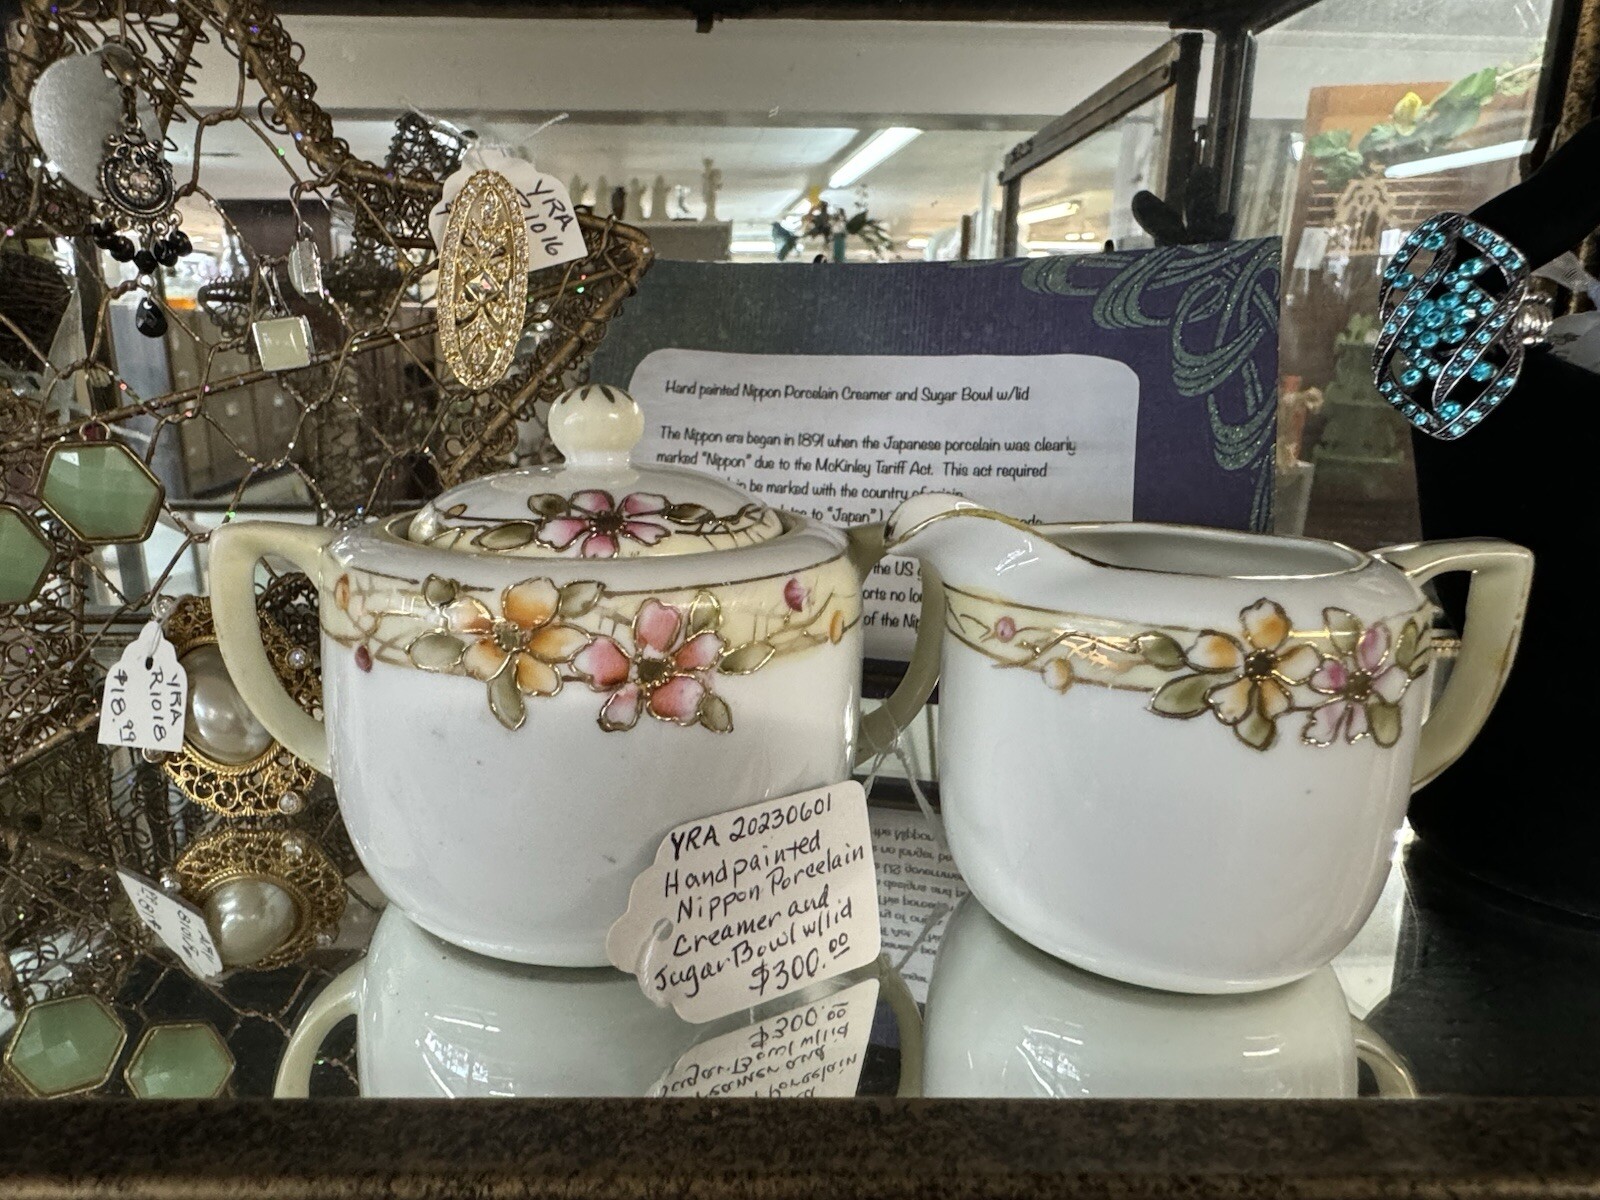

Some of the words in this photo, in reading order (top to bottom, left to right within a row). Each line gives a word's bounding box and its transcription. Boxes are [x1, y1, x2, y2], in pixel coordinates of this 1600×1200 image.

[527, 179, 574, 232] YRA
[665, 380, 697, 395] Hand
[700, 383, 740, 399] painted
[742, 384, 781, 402] Nippon
[784, 385, 838, 400] Porcelain
[841, 386, 892, 401] Creamer
[895, 387, 918, 401] and
[920, 387, 958, 405] Sugar
[961, 387, 993, 401] Bowl
[996, 386, 1030, 401] w/lid
[661, 425, 680, 440] The
[684, 428, 722, 446] Nippon
[725, 433, 744, 444] era
[746, 431, 781, 448] began
[784, 434, 794, 445] in
[798, 433, 824, 447] 1891
[828, 434, 858, 449] when
[862, 435, 880, 450] the
[883, 435, 941, 454] Japanese
[944, 436, 1000, 454] porcelain
[1004, 441, 1030, 452] was
[1034, 435, 1077, 456] clearly
[656, 450, 698, 465] marked
[702, 451, 752, 471] "Nippon"
[754, 455, 775, 470] due
[779, 458, 790, 470] to
[794, 456, 812, 471] the
[815, 457, 871, 477] McKinley
[875, 460, 907, 475] Tariff
[909, 461, 934, 476] Act.
[943, 461, 969, 477] This
[972, 463, 992, 477] act
[996, 462, 1048, 481] required
[750, 479, 763, 492] be
[766, 480, 809, 496] marked
[812, 483, 836, 497] with
[840, 483, 858, 498] the
[861, 485, 908, 502] country
[811, 508, 824, 521] to
[895, 561, 913, 577] US
[862, 588, 886, 600] orts
[890, 591, 906, 602] no
[863, 611, 879, 626] of
[881, 612, 899, 628] the
[149, 666, 166, 742] R1018
[167, 674, 182, 726] YRA
[670, 826, 721, 861] YRA
[729, 793, 832, 841] 20230601
[676, 888, 761, 924] Nippon
[765, 842, 865, 892] Porcelain
[672, 910, 781, 958] Creamer
[788, 884, 829, 919] and
[654, 957, 731, 998] Sugar
[730, 923, 796, 969] Bowl
